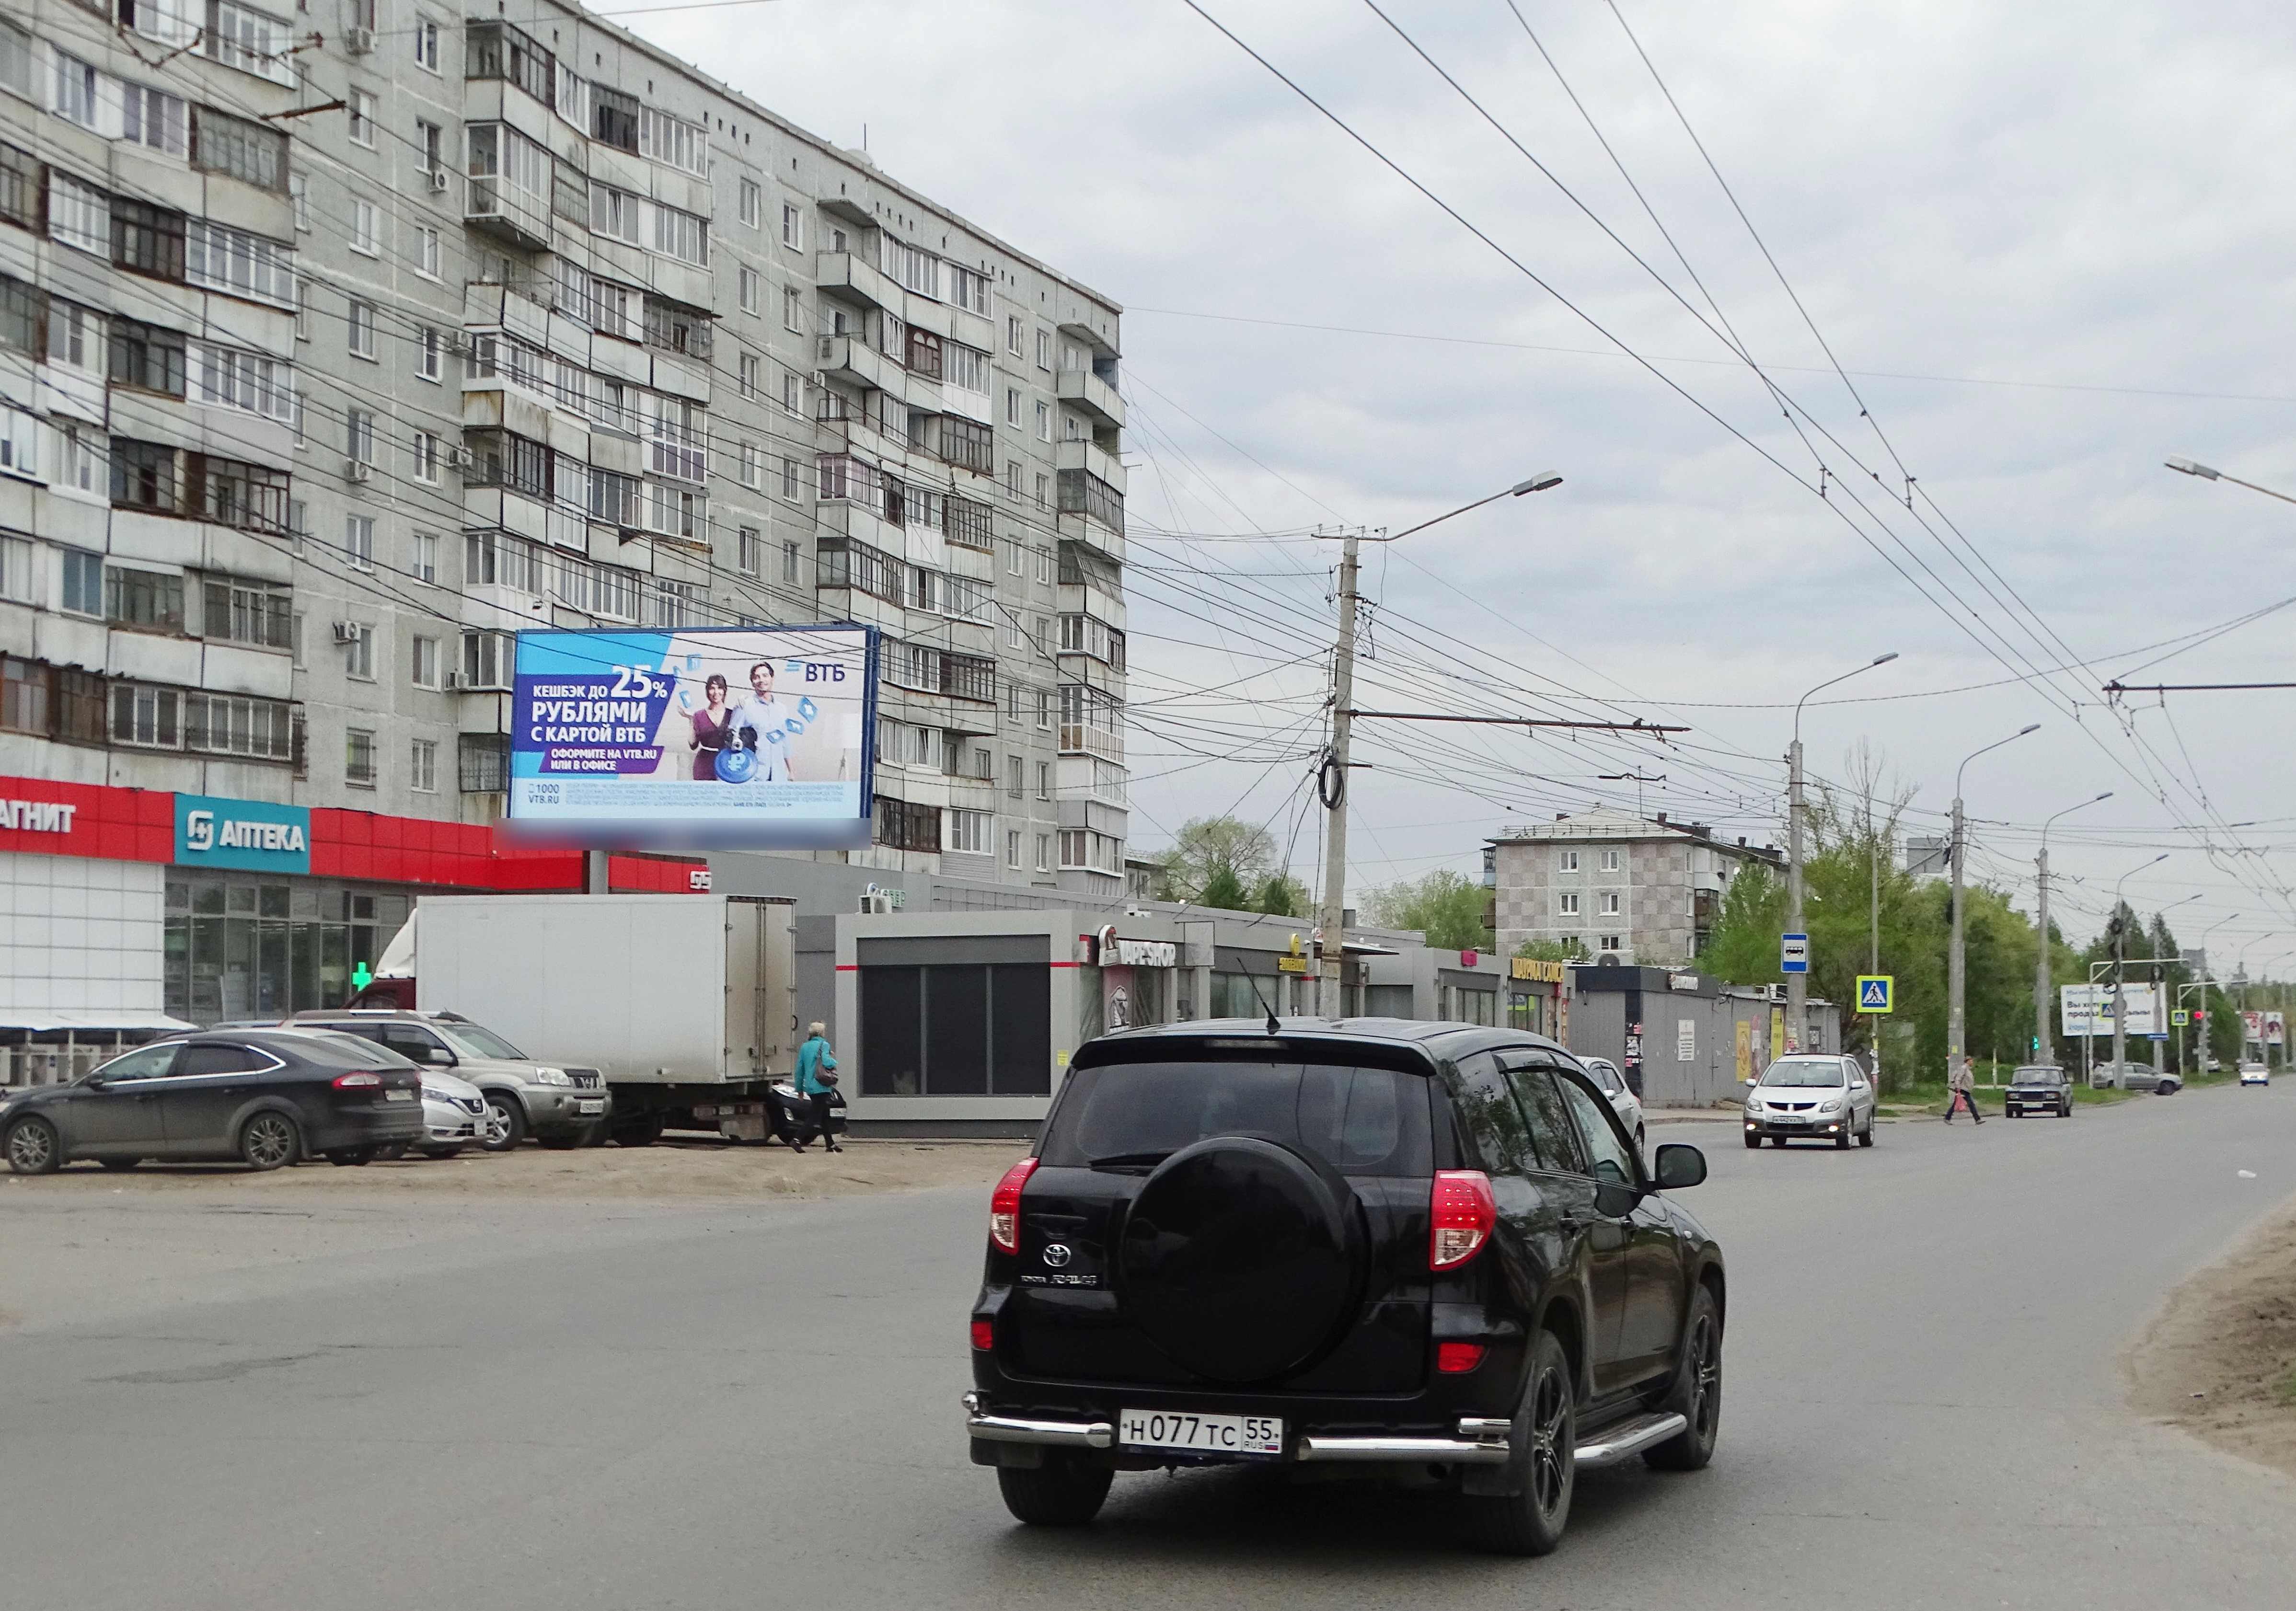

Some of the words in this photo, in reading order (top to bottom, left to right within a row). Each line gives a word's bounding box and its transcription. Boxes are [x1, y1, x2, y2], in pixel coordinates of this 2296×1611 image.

[806, 664, 845, 681] ВТБ
[533, 685, 586, 698] КЕШБЭК
[588, 686, 608, 700] ДО
[610, 665, 668, 699] 25%
[531, 701, 647, 723] РУБЛЯМИ
[531, 726, 542, 742] С
[545, 723, 612, 742] КАРТОЙ
[615, 727, 646, 743] ВТБ
[551, 748, 606, 759] ОФОРМИТЕ
[607, 749, 622, 759] НА
[623, 749, 657, 760] VTB.RU
[551, 760, 574, 770] ИЛИ
[574, 760, 581, 770] В
[582, 760, 617, 771] ОФИСЕ
[536, 783, 559, 794] 1000
[529, 795, 559, 804] VTB.RU
[219, 820, 305, 852] АПТЕКА
[1246, 1419, 1272, 1440] 55
[1244, 1440, 1264, 1450] RUS
